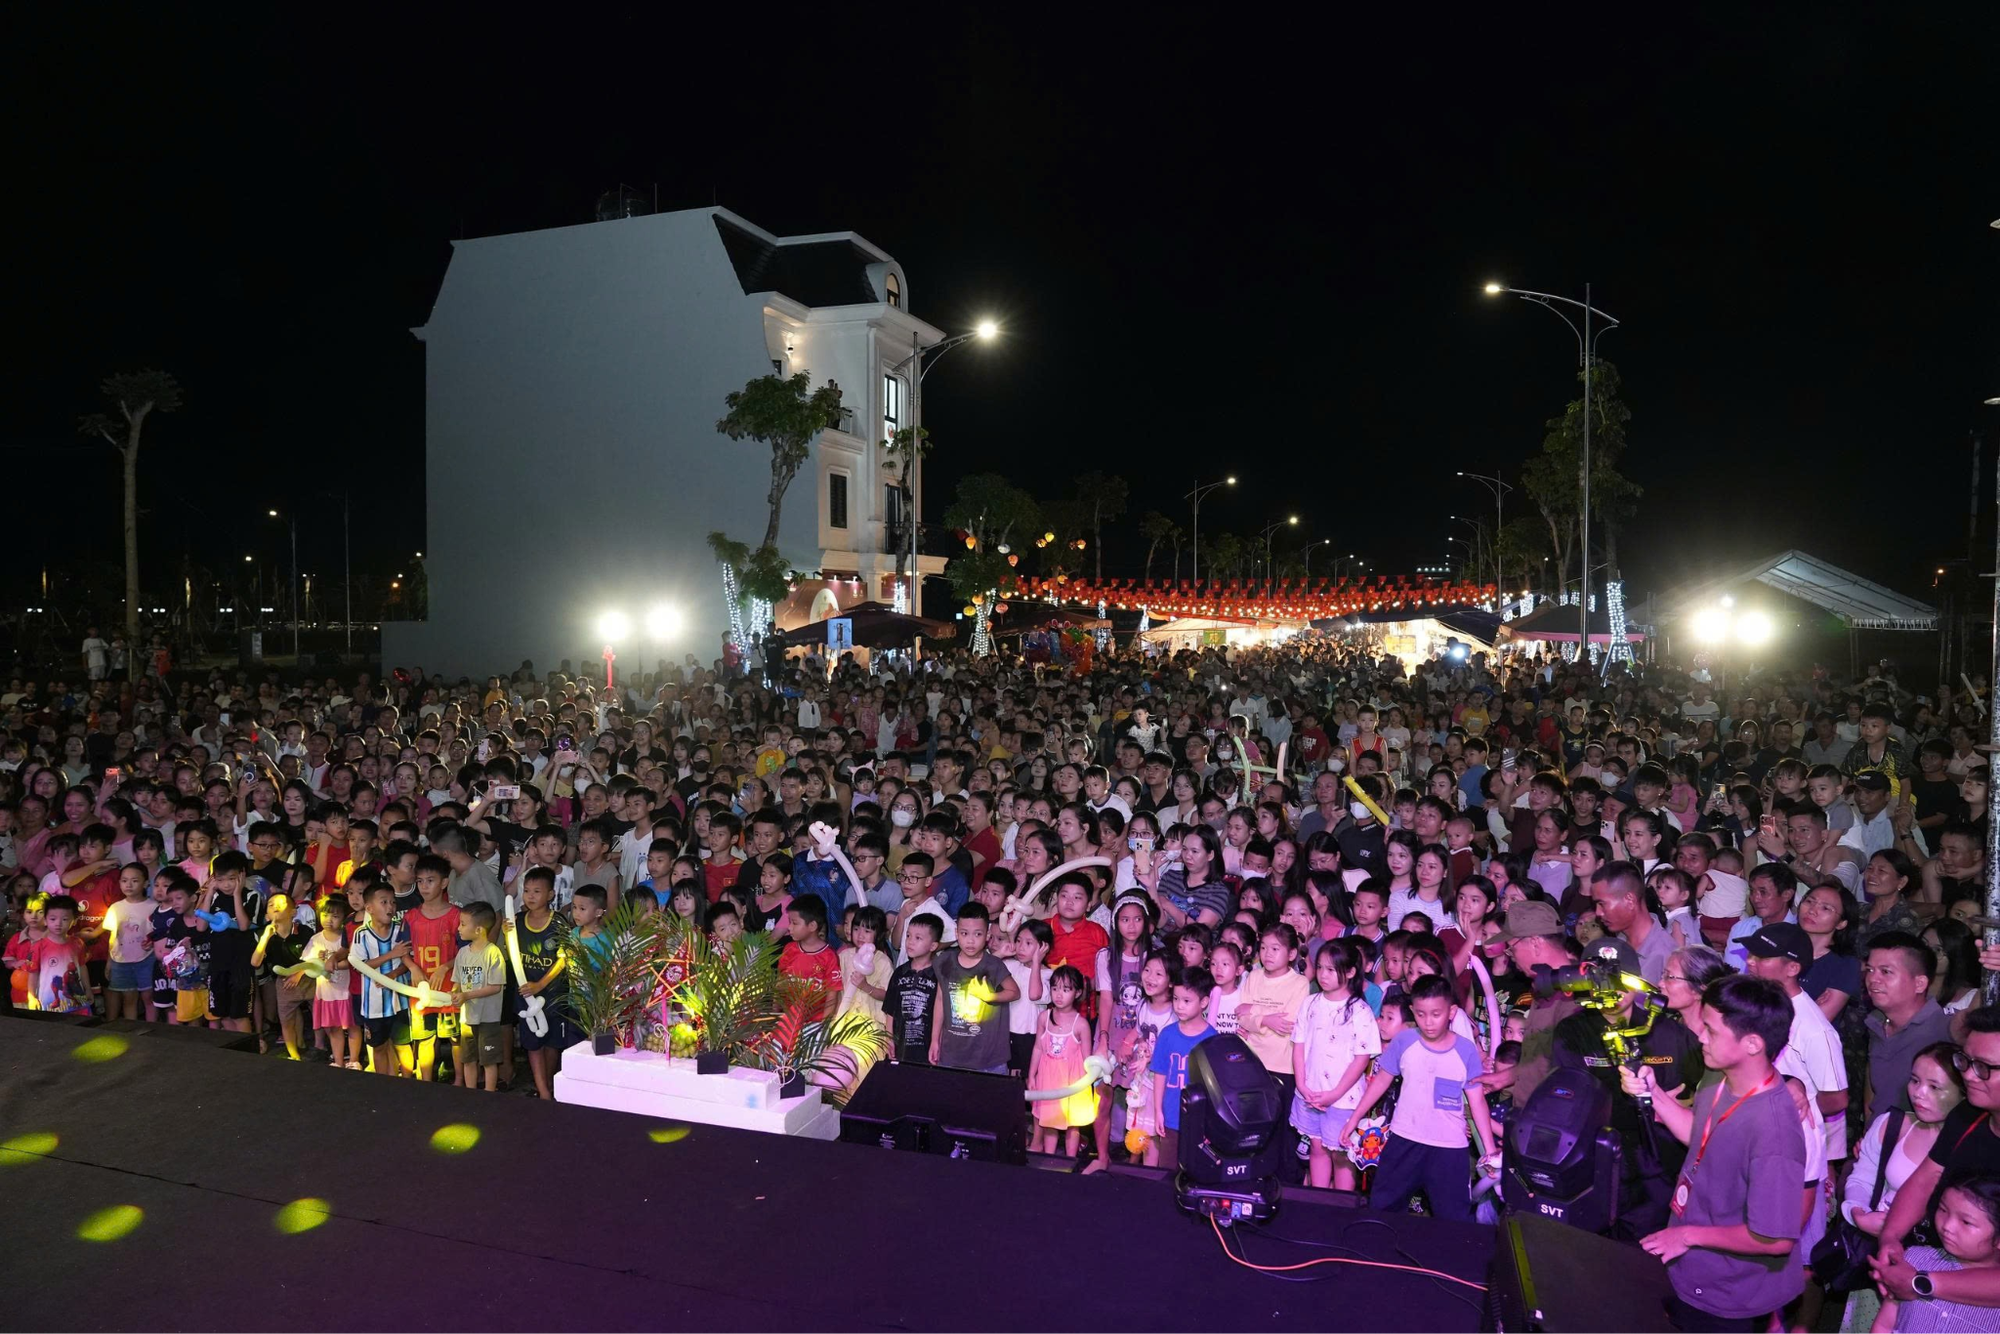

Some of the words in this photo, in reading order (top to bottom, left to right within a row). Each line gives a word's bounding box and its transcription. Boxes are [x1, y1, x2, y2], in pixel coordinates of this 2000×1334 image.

[418, 946, 441, 973] 19
[520, 952, 553, 967] TIHAD
[1167, 1053, 1189, 1090] H
[1226, 1165, 1247, 1175] SVT
[1541, 1204, 1564, 1218] SVT
